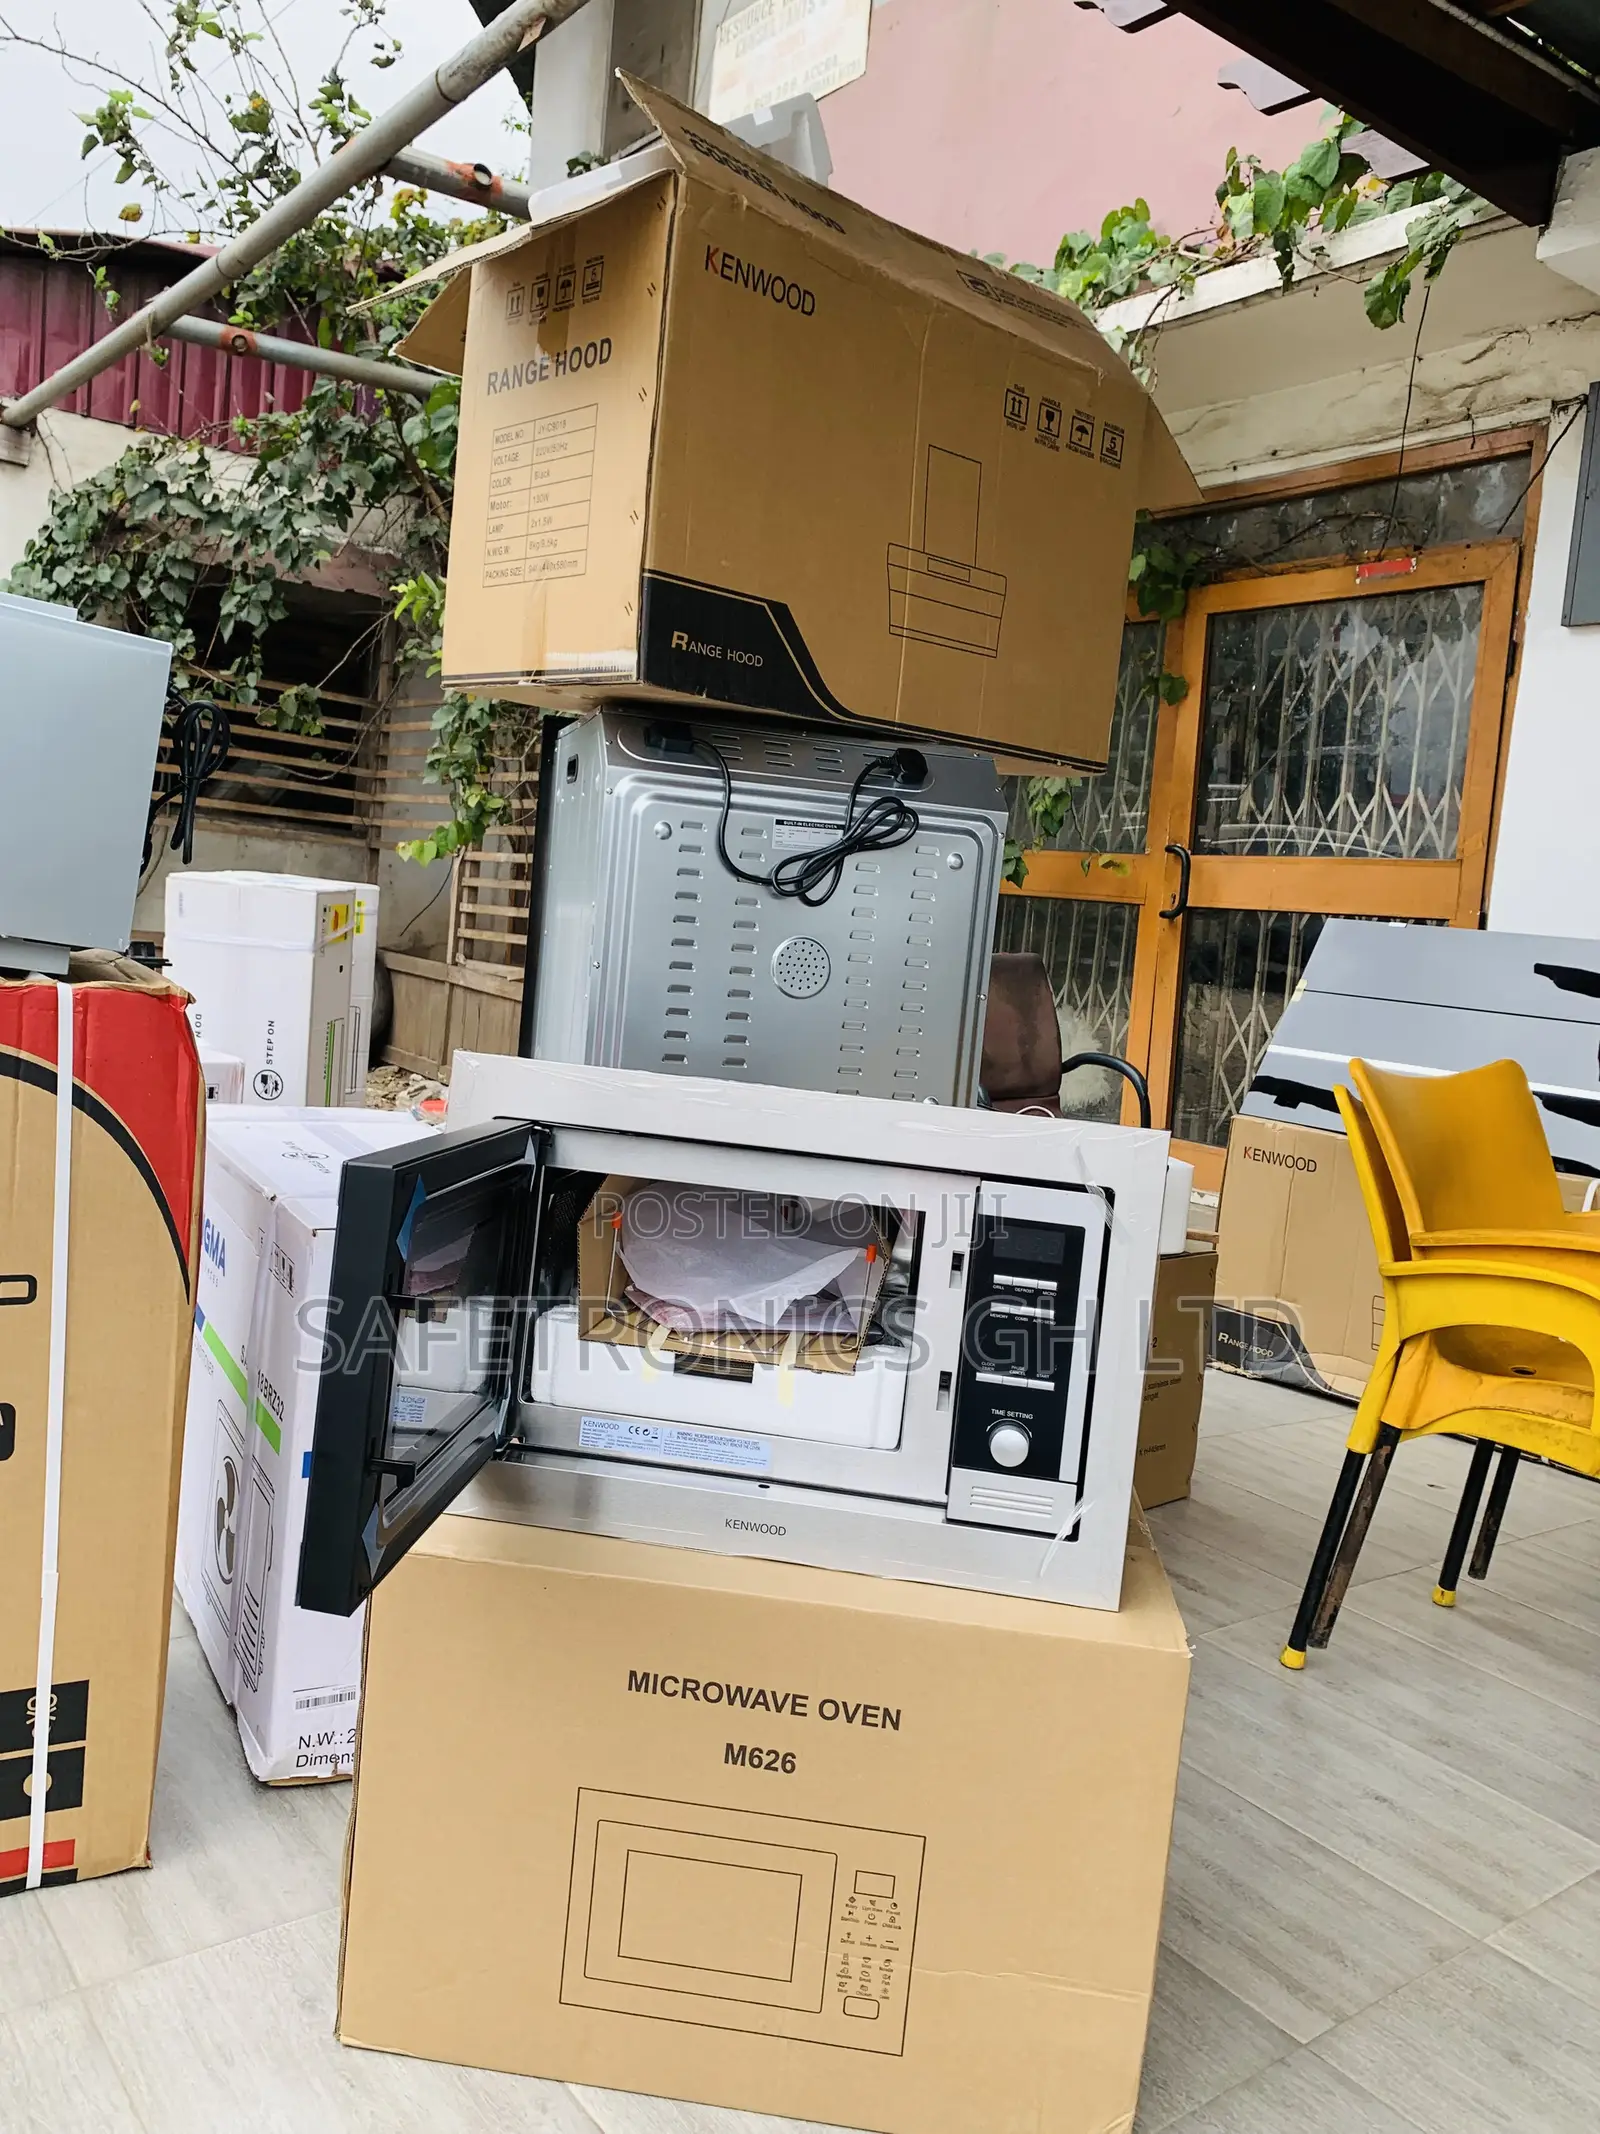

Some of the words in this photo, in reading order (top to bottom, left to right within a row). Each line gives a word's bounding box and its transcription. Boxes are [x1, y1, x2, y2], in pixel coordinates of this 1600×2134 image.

[704, 244, 816, 317] KENWOOD
[487, 356, 550, 397] RANGE
[555, 337, 613, 378] HOOD
[671, 630, 722, 659] RANGE
[727, 648, 764, 667] HOOD
[267, 1020, 275, 1035] ON
[265, 1037, 274, 1065] STEP
[1243, 1146, 1318, 1173] KENWOOD
[203, 1217, 226, 1277] GMA
[1217, 1331, 1249, 1350] RANGE
[1248, 1345, 1274, 1358] HOOD
[583, 1419, 620, 1431] KENWOOD
[991, 1408, 1006, 1417] TIME
[1006, 1410, 1034, 1420] SETTING
[725, 1518, 787, 1537] KENWOOD
[627, 1669, 809, 1717] MICROWAVE
[818, 1698, 902, 1731] OVEN
[346, 1728, 357, 1744] 2
[723, 1742, 797, 1774] M626
